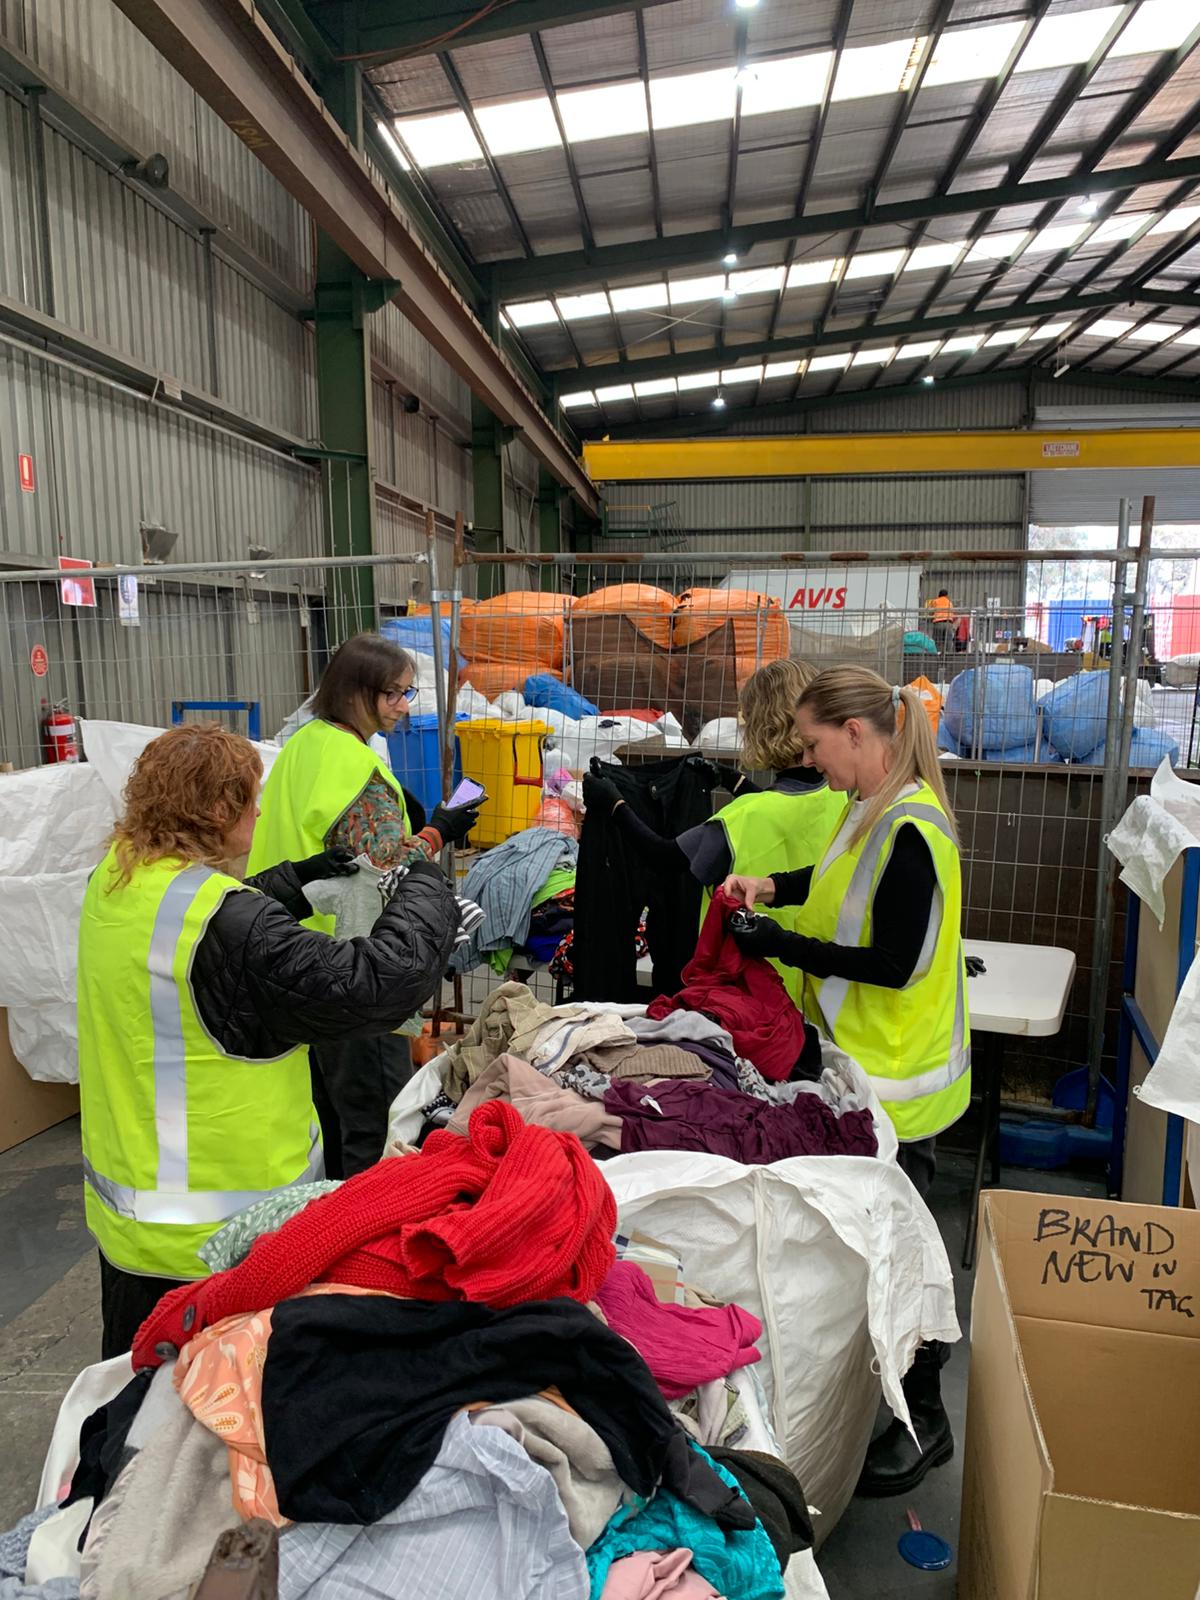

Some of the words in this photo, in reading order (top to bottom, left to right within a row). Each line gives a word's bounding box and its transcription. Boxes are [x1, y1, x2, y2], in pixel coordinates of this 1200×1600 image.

[789, 587, 848, 609] AVIS
[1033, 1208, 1175, 1255] BRAND
[1041, 1250, 1135, 1285] NEW
[1152, 1259, 1177, 1278] IN
[1140, 1288, 1195, 1318] TAG
